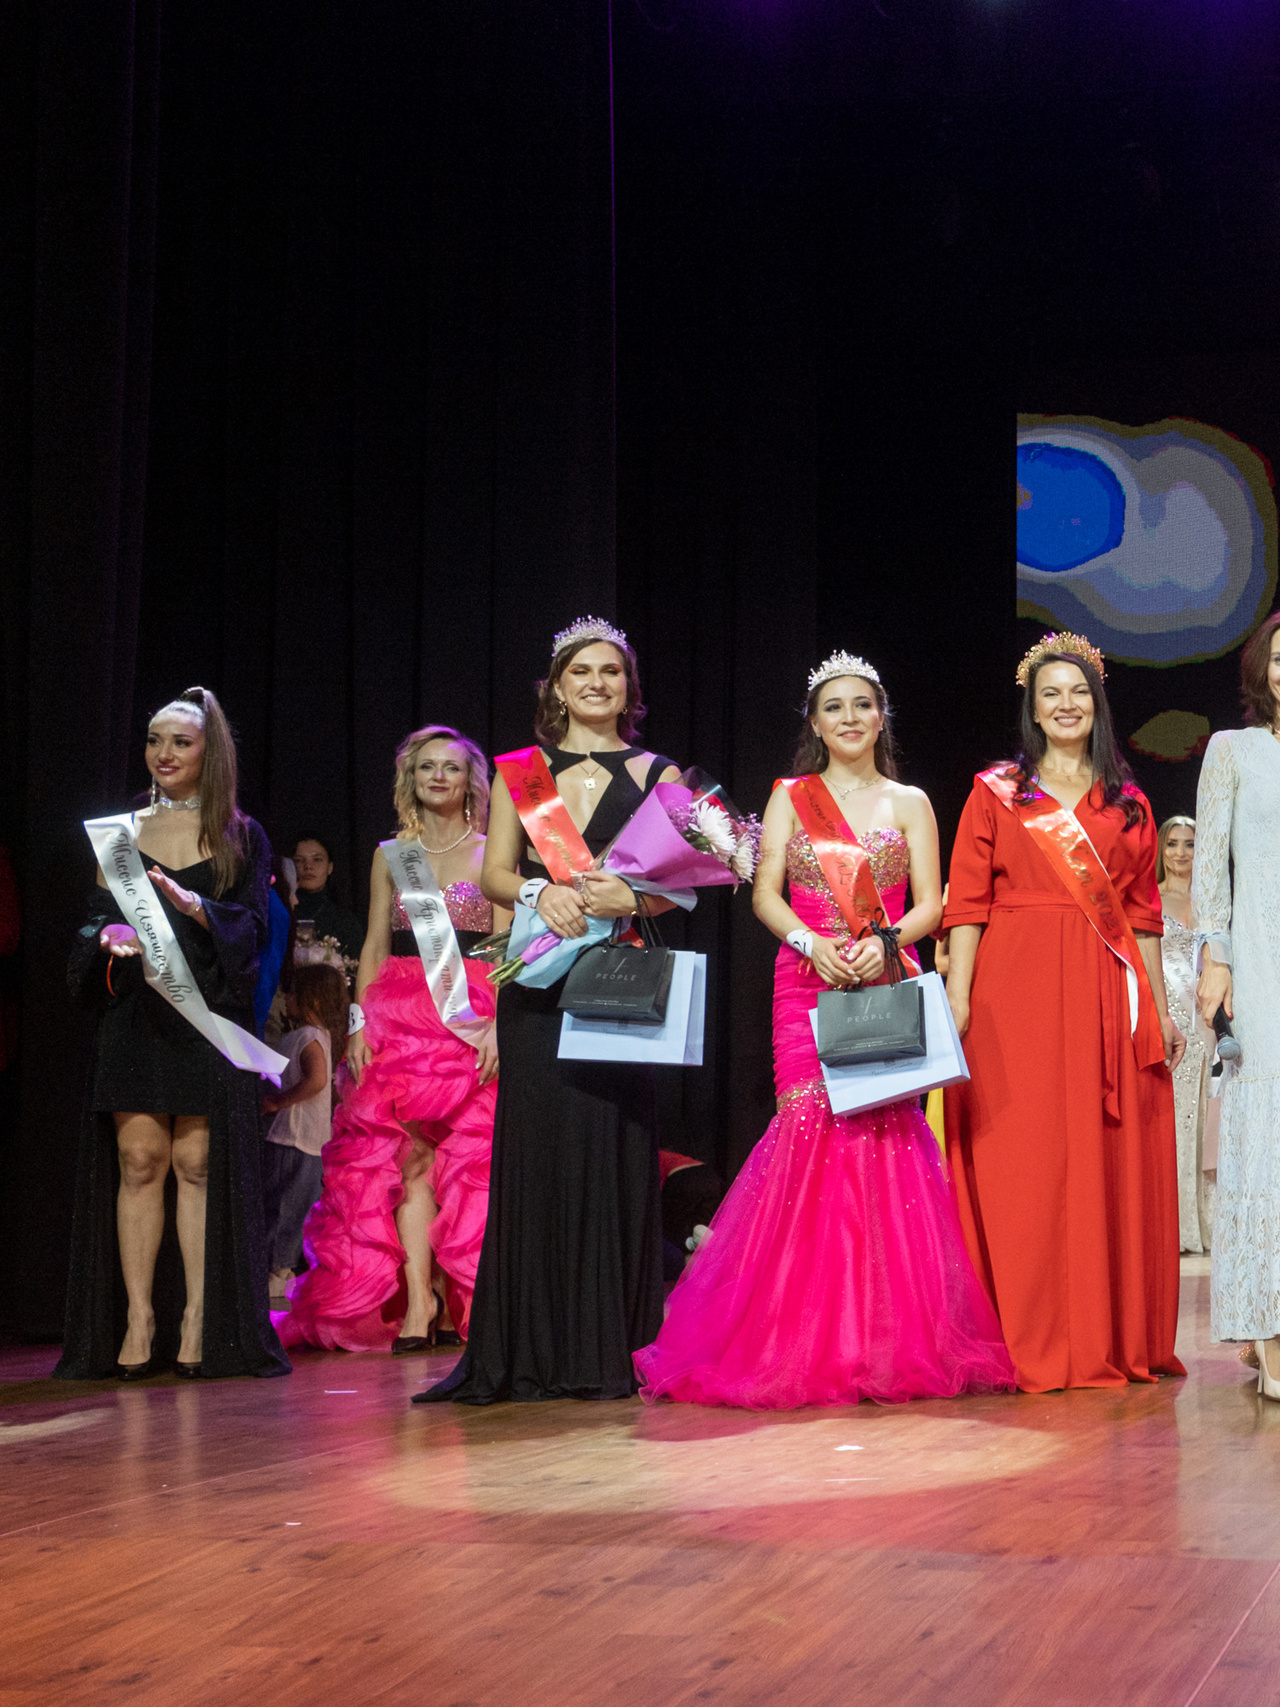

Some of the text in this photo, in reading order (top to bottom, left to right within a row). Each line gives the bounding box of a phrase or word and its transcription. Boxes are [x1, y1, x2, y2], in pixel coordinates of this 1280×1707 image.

[399, 849, 421, 892] Миссис
[109, 832, 193, 1003] Миссис Изящество
[595, 972, 637, 981] PEOPLE
[847, 1012, 892, 1023] PEOPLE
